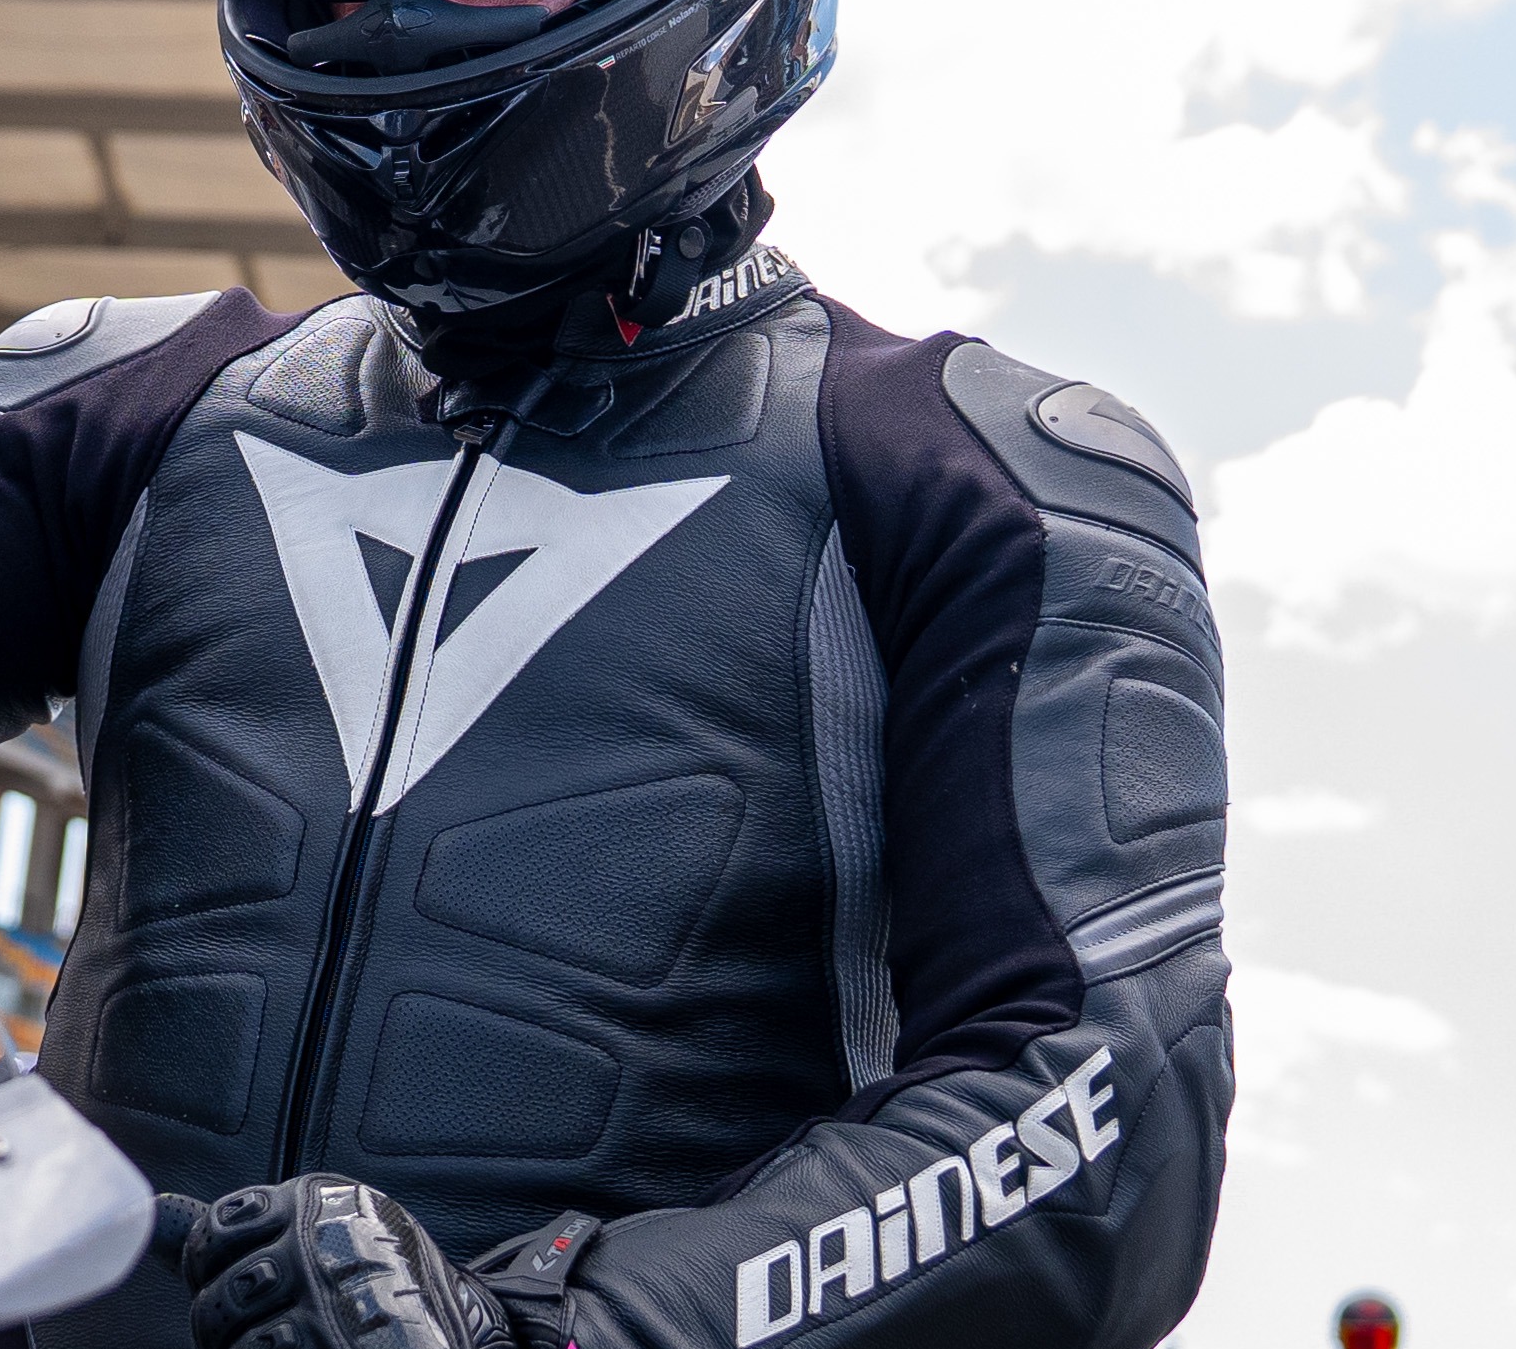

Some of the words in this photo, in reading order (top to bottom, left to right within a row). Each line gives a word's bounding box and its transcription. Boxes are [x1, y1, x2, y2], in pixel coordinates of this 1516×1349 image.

[615, 38, 647, 61] REPARTO
[646, 25, 667, 44] CORSE
[736, 1045, 1120, 1349] DAINESE
[546, 1218, 591, 1257] TAICHI
